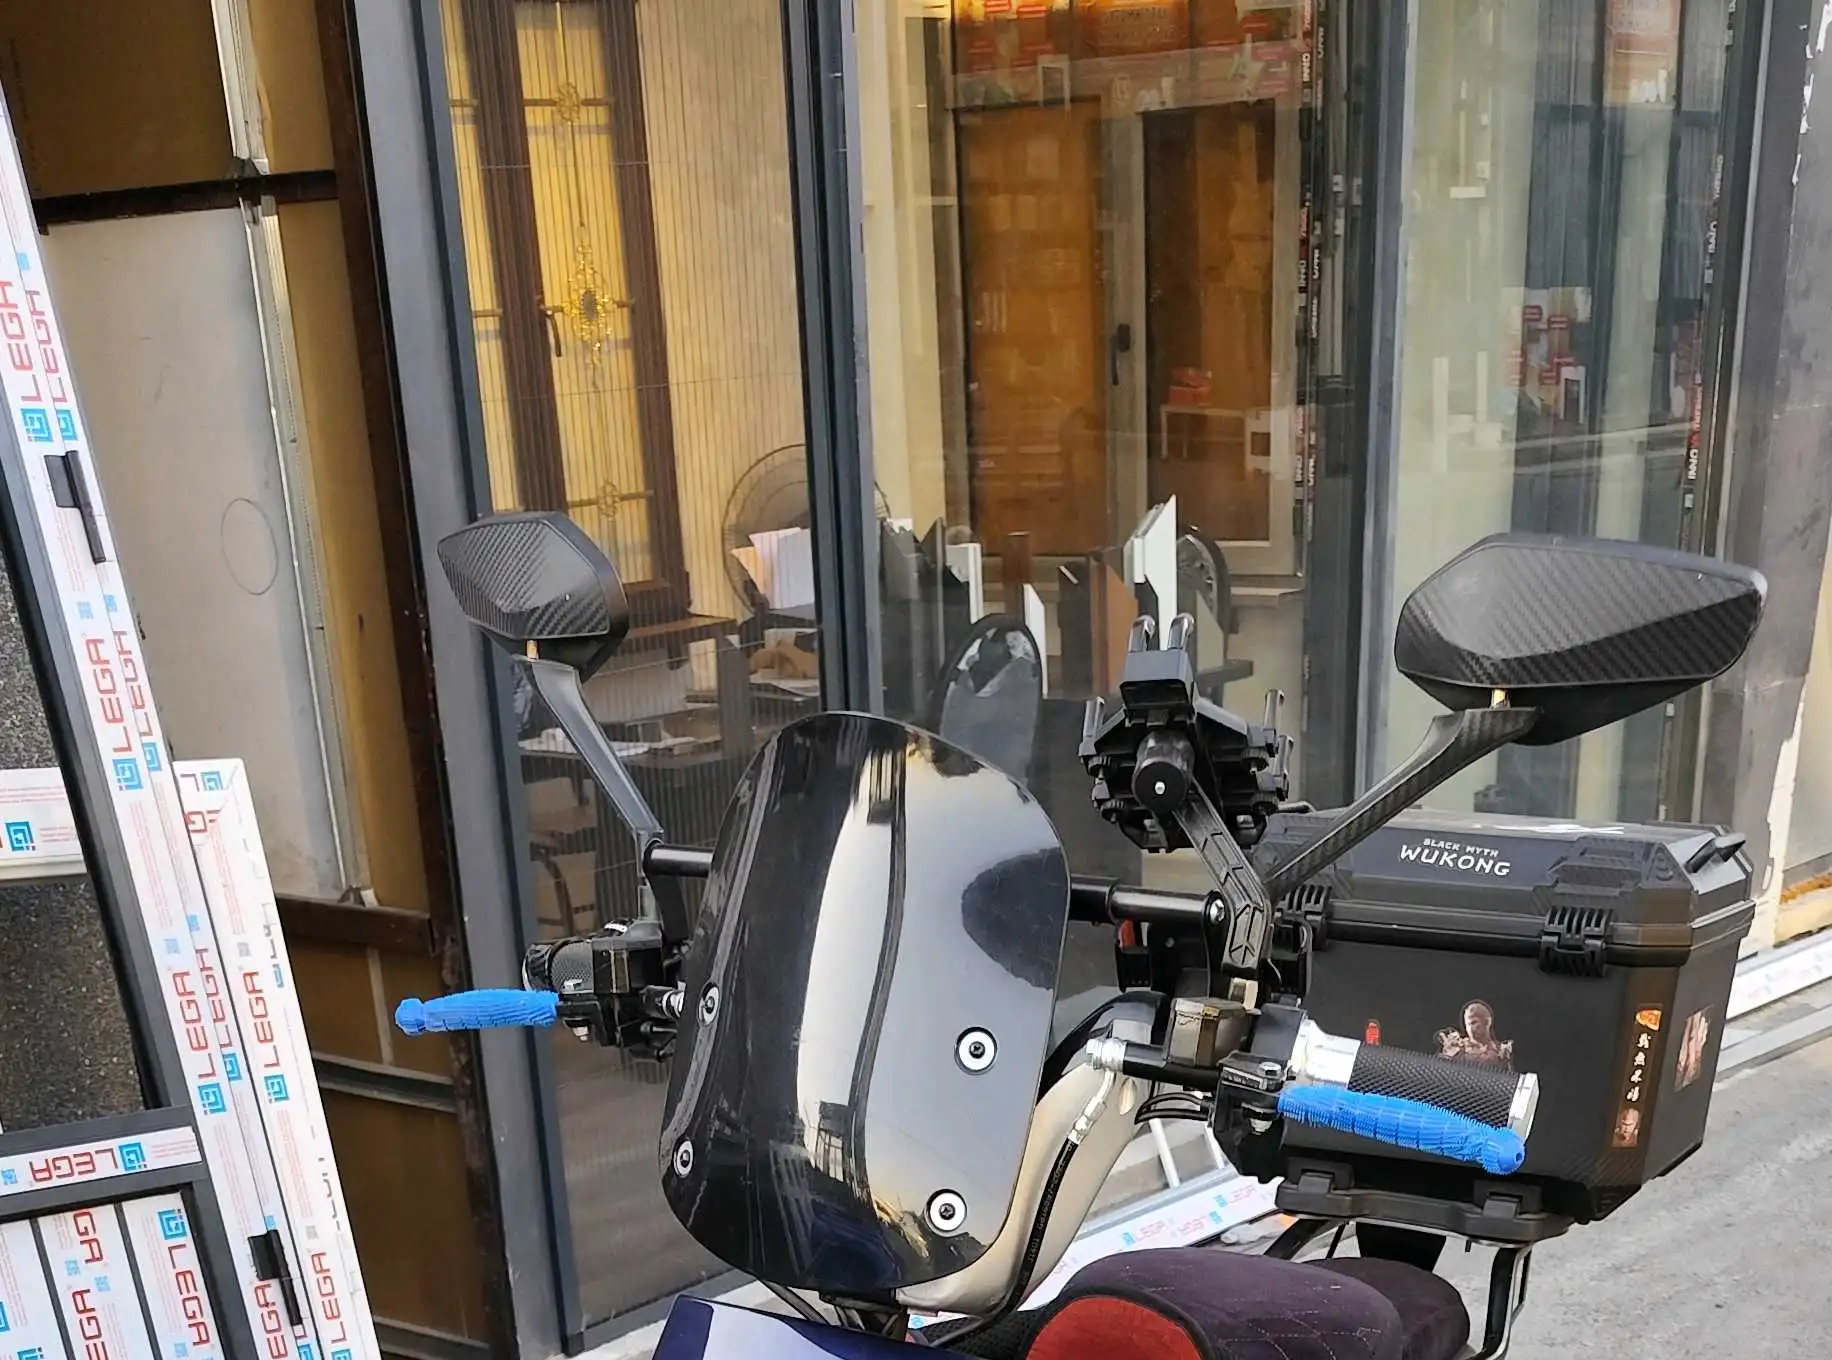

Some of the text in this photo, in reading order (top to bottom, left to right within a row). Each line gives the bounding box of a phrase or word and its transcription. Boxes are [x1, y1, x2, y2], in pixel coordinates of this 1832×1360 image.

[0, 280, 42, 403] LEGA
[85, 638, 133, 753] LEGA
[112, 630, 154, 738] LEGA
[1400, 844, 1511, 876] WUKONG
[1423, 838, 1499, 858] BLACK MYTH
[172, 971, 217, 1080] LEGA
[242, 971, 281, 1068] LEGA
[29, 1148, 119, 1184] LEGA
[168, 1243, 210, 1347] LEGA
[311, 1251, 348, 1345] LEGA
